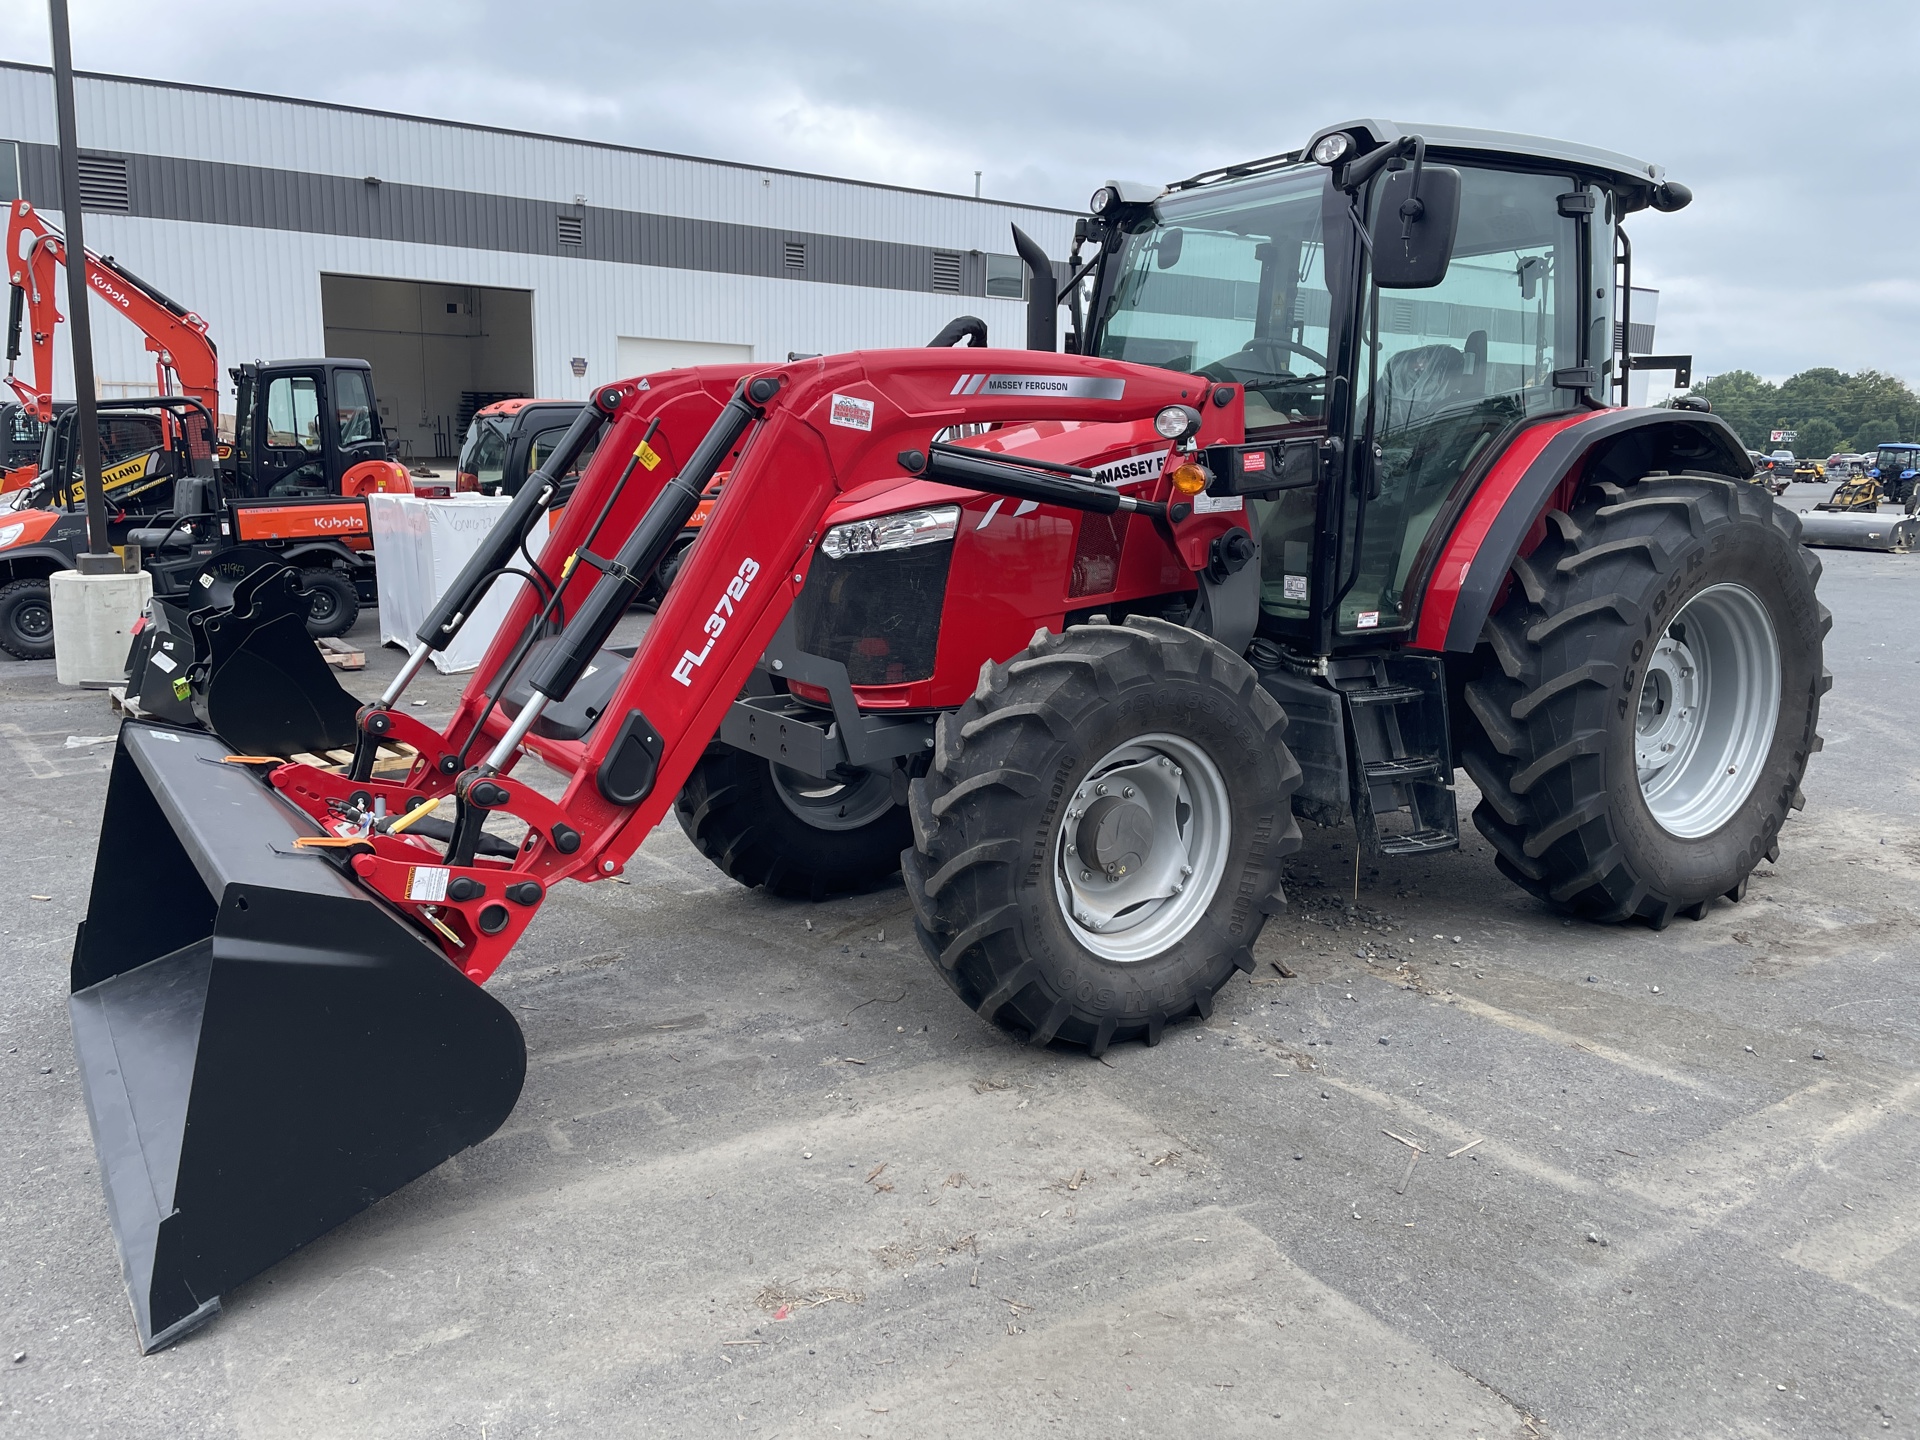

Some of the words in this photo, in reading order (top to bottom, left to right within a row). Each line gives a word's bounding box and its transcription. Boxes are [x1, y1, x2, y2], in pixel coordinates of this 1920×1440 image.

[91, 273, 130, 307] Kubota
[988, 380, 1023, 390] MASSEY
[1025, 381, 1068, 391] FERGUSON
[102, 463, 142, 486] OLLAND
[1100, 458, 1153, 484] MASSEY
[314, 515, 364, 529] Kubota
[670, 556, 761, 688] FL.3723
[1616, 567, 1682, 720] 460/85
[1686, 546, 1705, 576] R
[1709, 528, 1744, 558] 34
[1116, 687, 1221, 722] 380/85
[1217, 707, 1241, 732] R
[1234, 728, 1264, 766] 24
[1021, 754, 1077, 890] TRELLEBORG
[1228, 813, 1276, 938] TRELLEBORG
[1056, 966, 1118, 1011] 600
[1123, 981, 1177, 1014] TM
